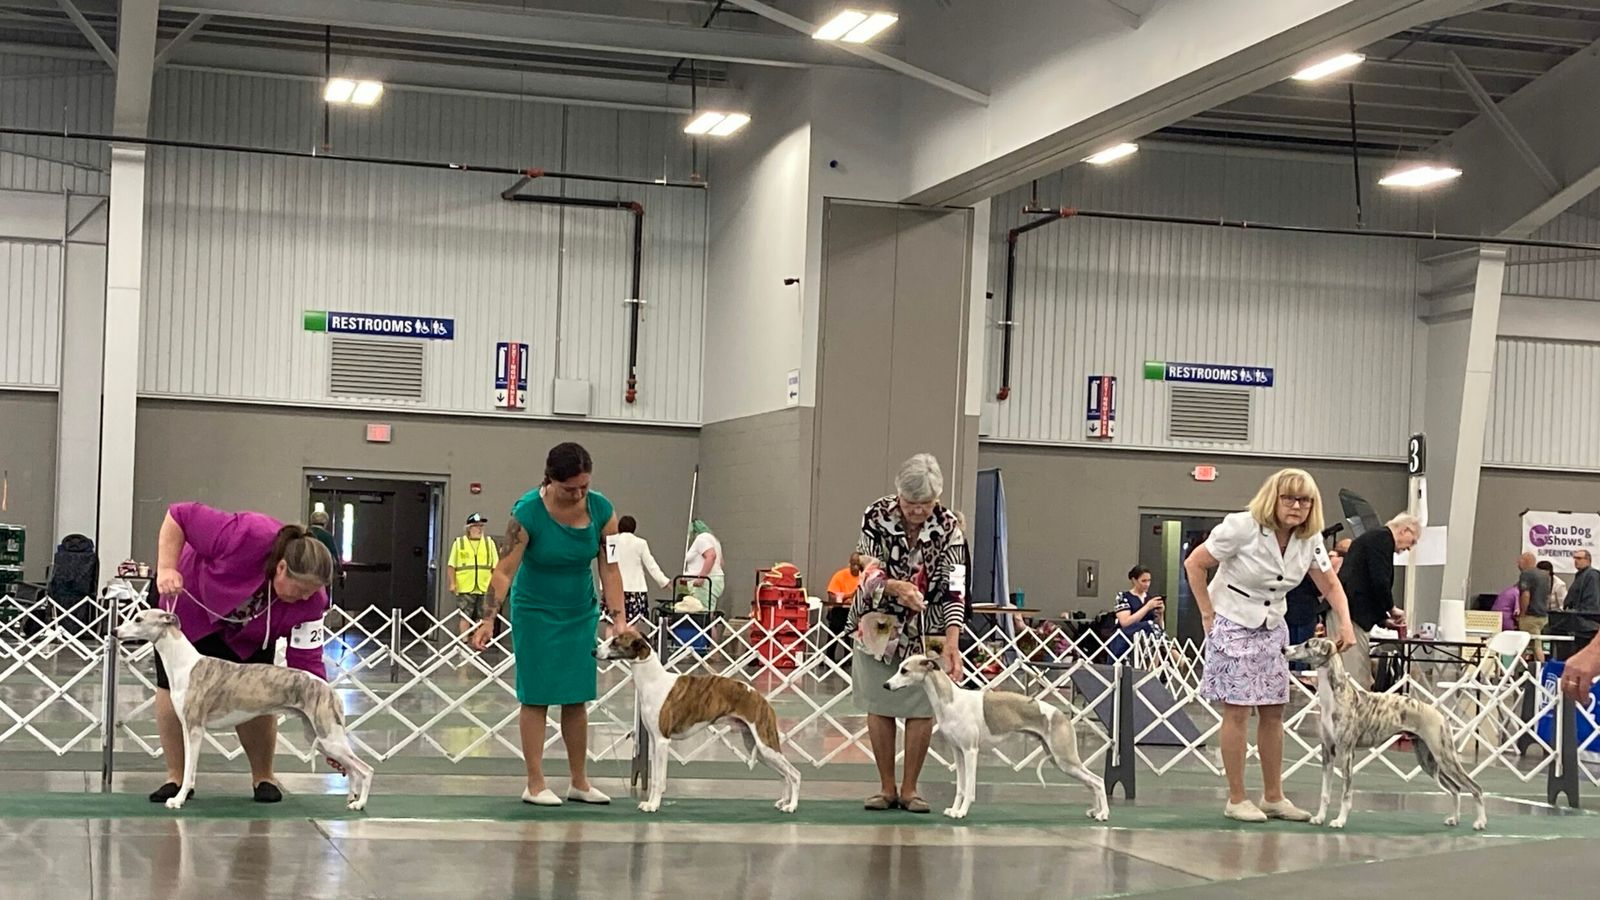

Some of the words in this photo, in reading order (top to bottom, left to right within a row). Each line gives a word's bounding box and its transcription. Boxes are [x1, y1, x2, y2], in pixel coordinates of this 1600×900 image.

[332, 316, 412, 333] RESTROOMS
[1169, 366, 1238, 381] RESTROOMS
[1410, 439, 1419, 472] 3
[1548, 525, 1568, 535] Rau
[1571, 526, 1592, 538] Dog
[1547, 536, 1583, 546] Shows
[609, 544, 616, 556] 7
